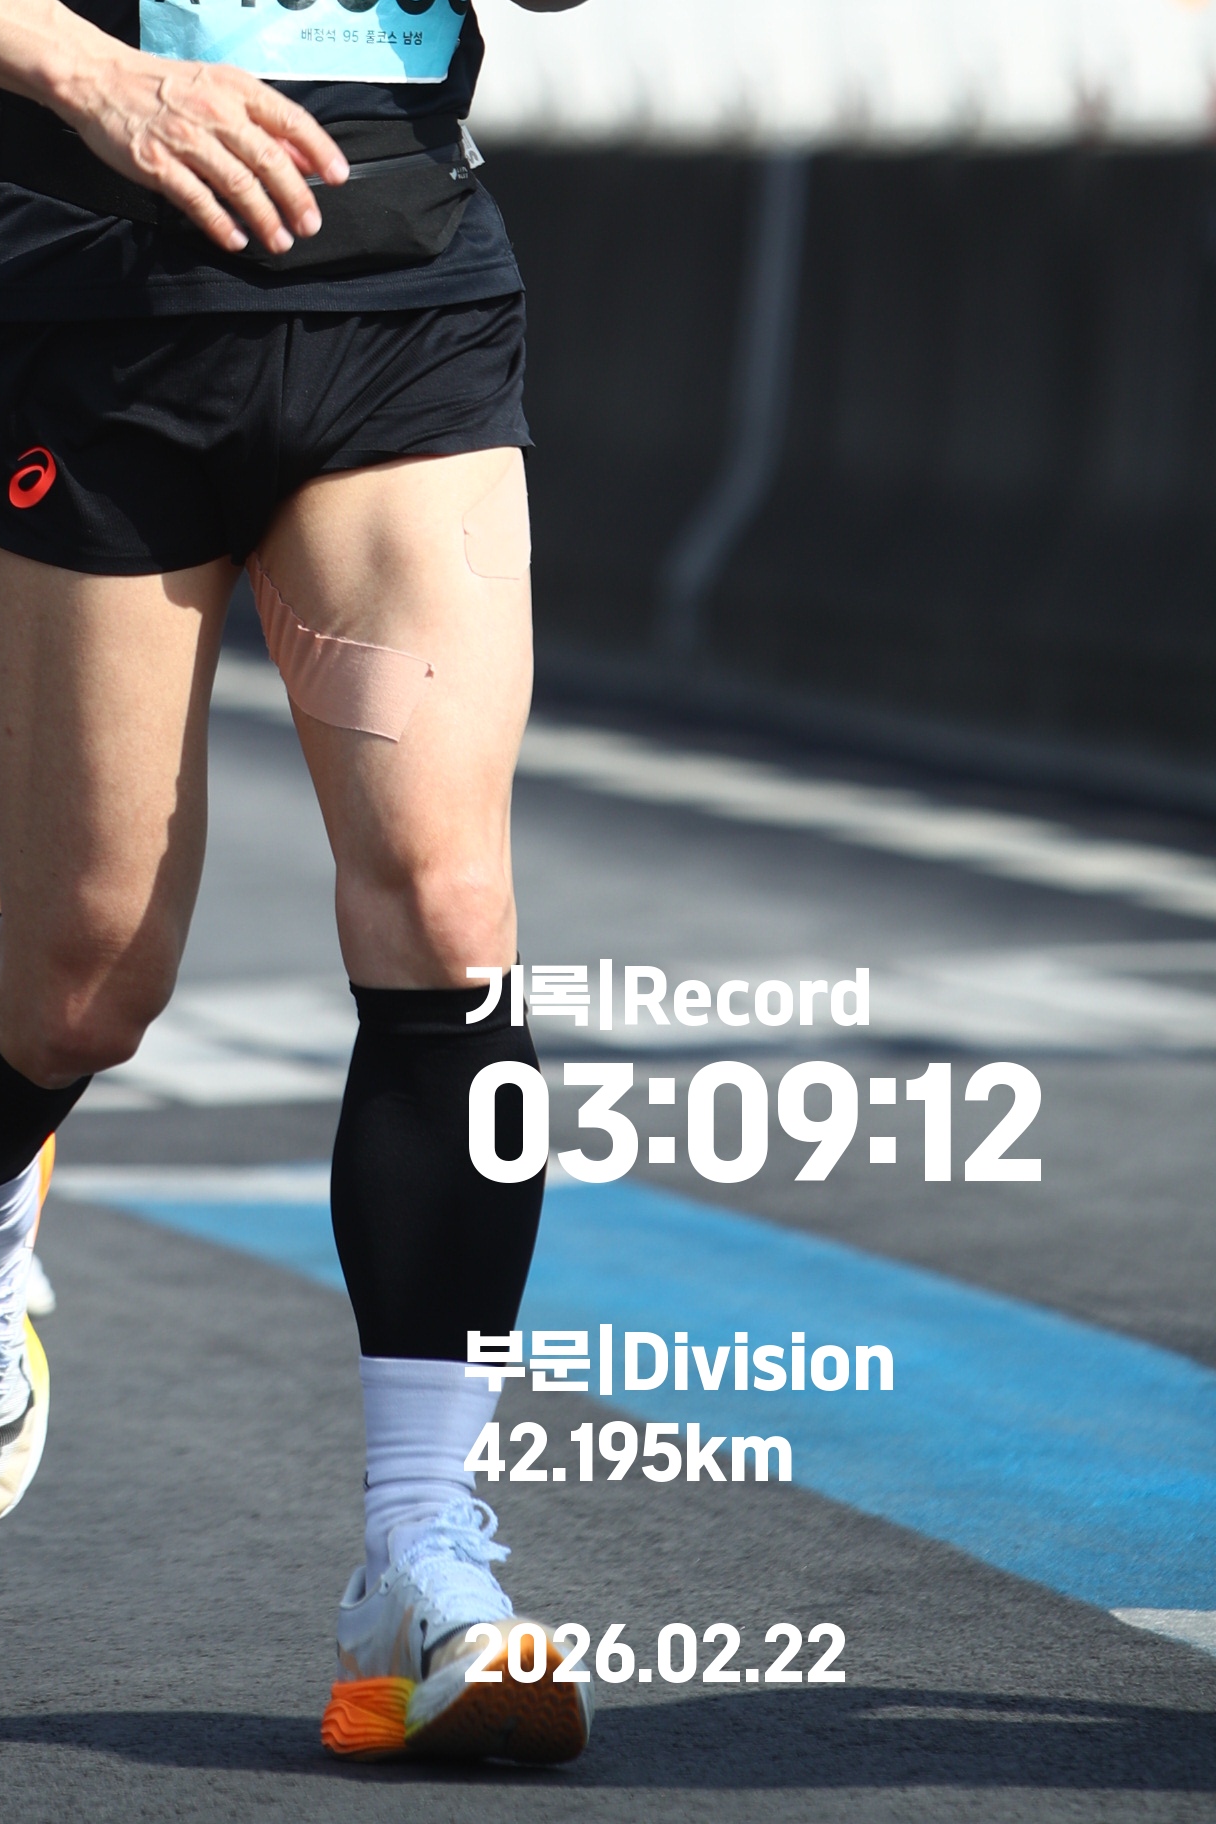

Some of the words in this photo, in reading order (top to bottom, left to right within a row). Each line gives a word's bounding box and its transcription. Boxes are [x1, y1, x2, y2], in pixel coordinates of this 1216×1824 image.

[343, 30, 359, 43] 95
[366, 30, 398, 44] 풀코스
[403, 30, 423, 46] 남성
